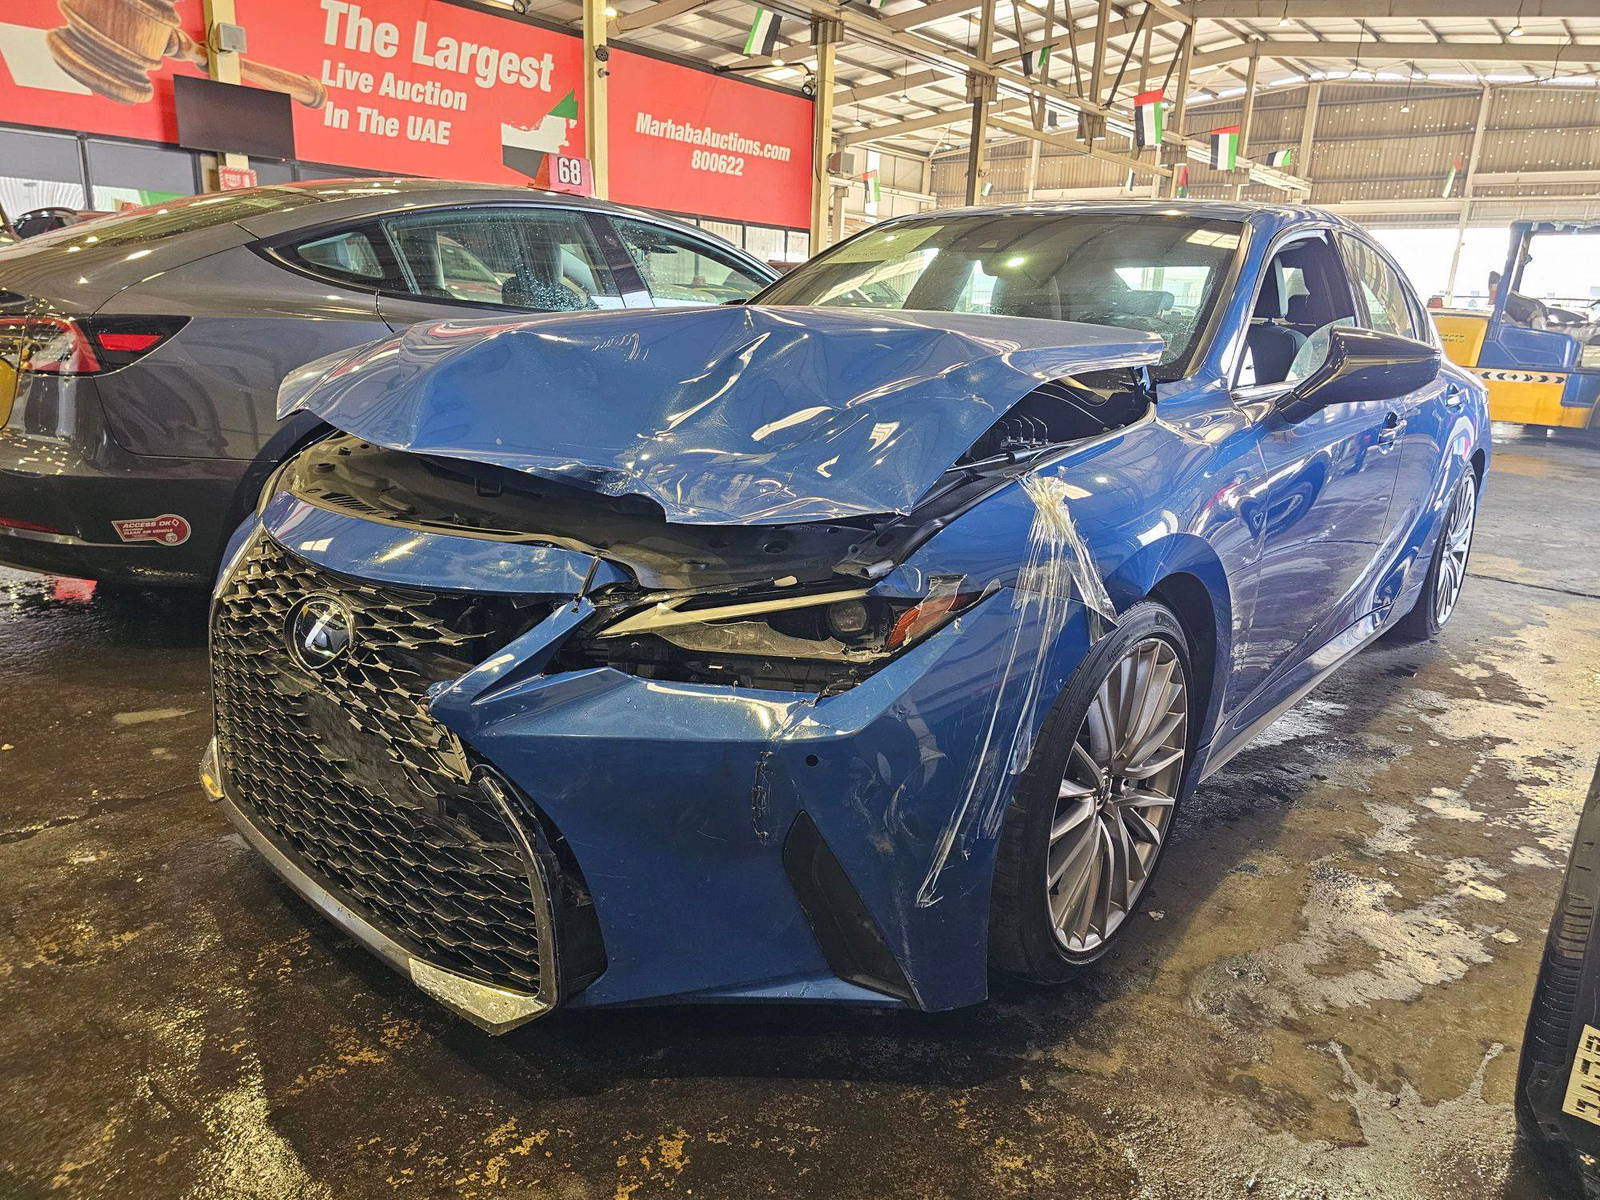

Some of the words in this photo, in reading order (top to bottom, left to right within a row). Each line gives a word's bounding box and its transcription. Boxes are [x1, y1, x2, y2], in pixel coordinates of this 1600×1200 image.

[320, 0, 399, 58] The
[412, 20, 554, 93] Largest
[321, 59, 374, 94] Live
[378, 71, 468, 112] Auction
[323, 100, 350, 130] In
[356, 106, 400, 137] The
[406, 115, 452, 146] UAE
[635, 111, 792, 162] MarhabaAuctions.com
[557, 157, 582, 186] 68
[691, 149, 745, 176] 800622
